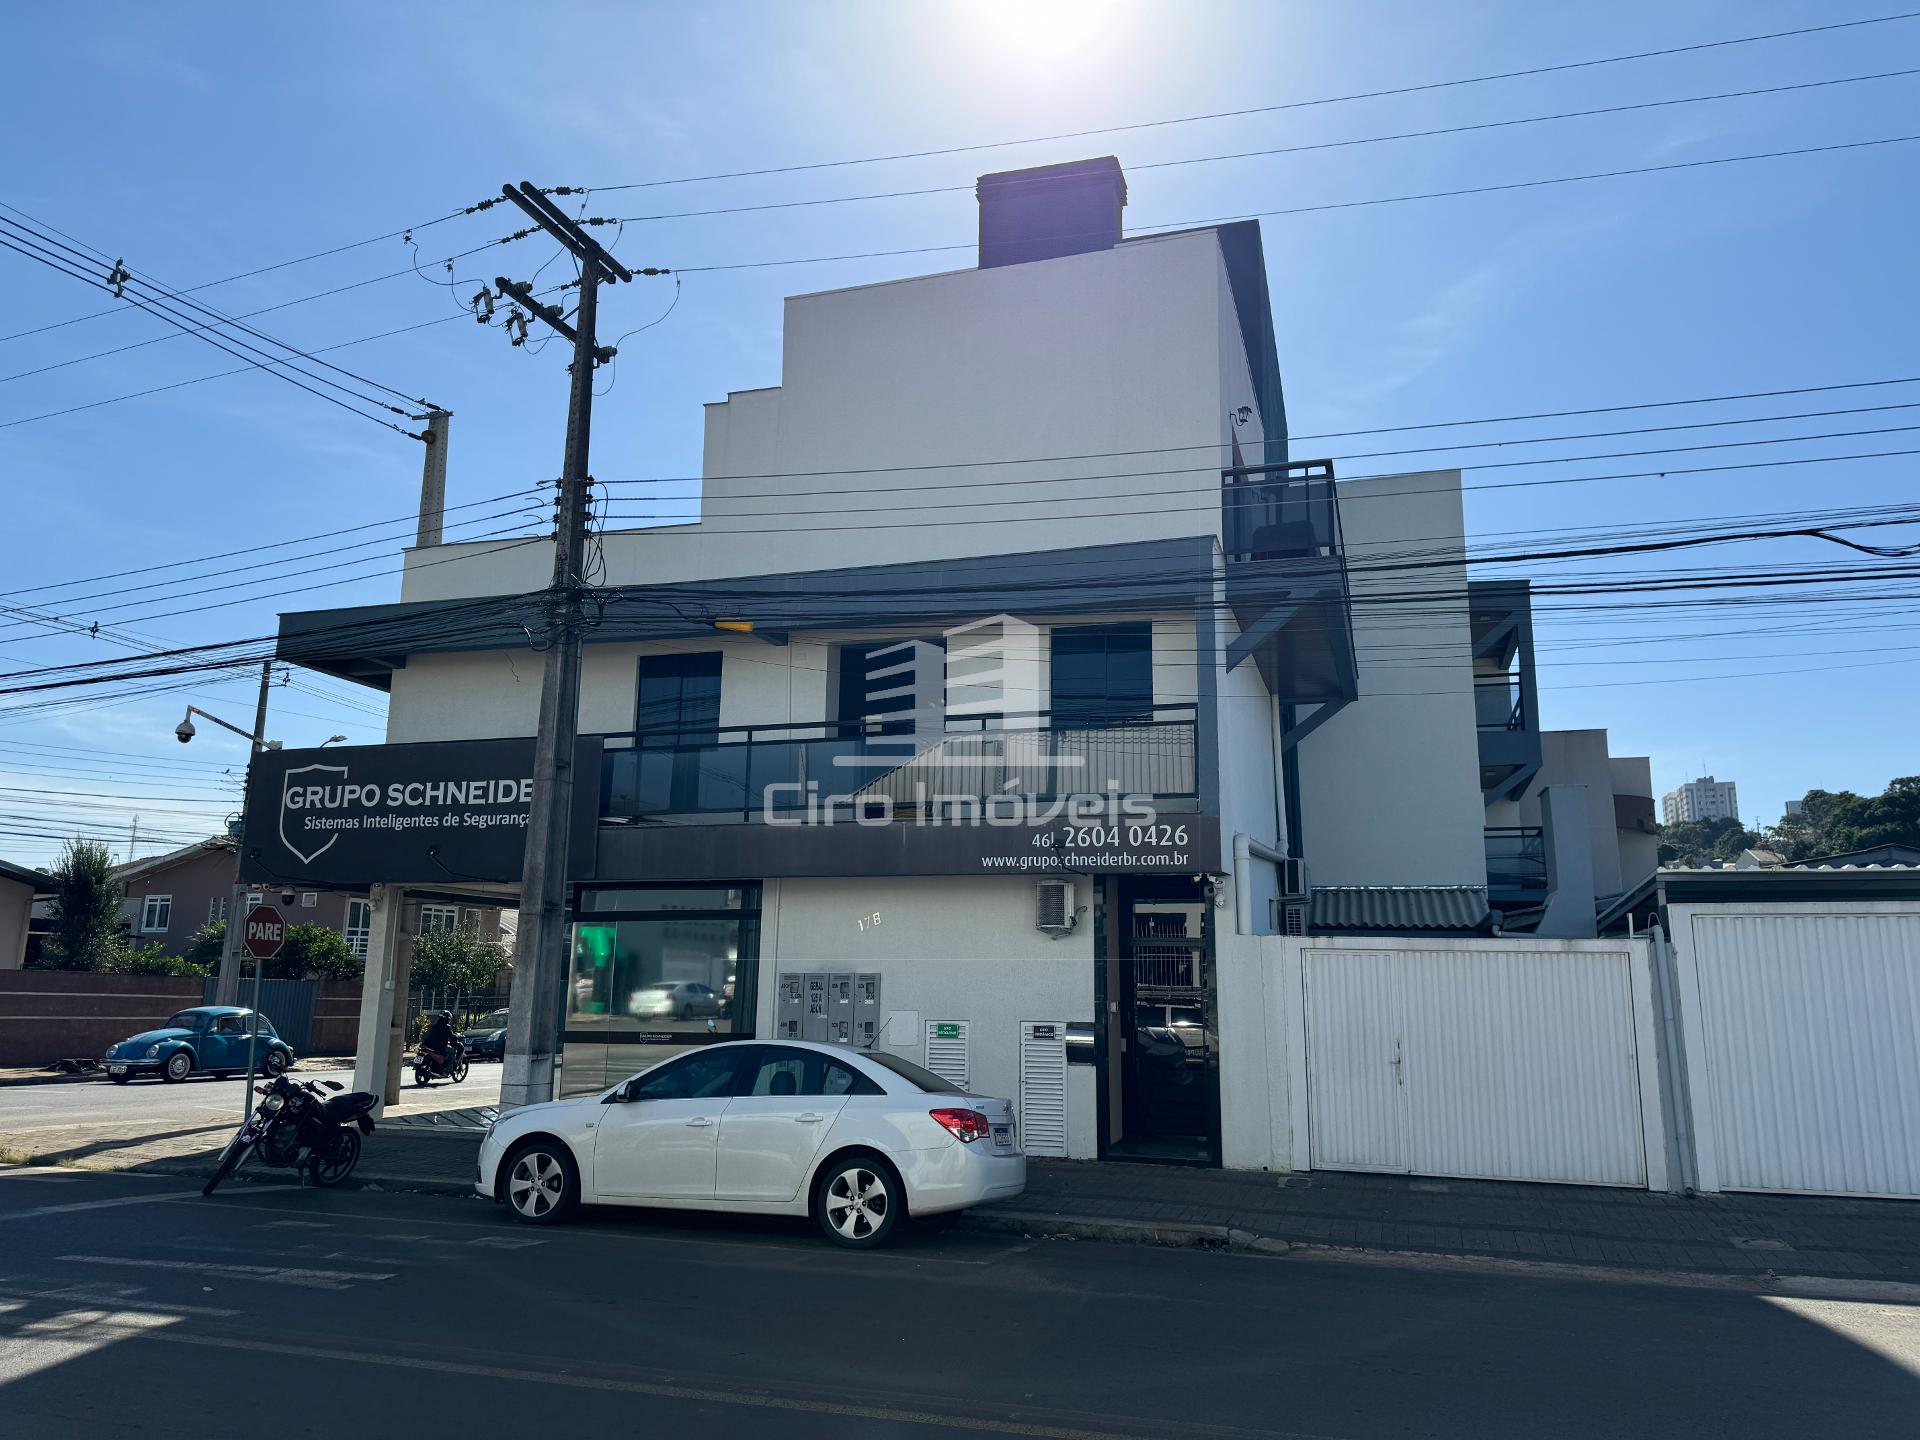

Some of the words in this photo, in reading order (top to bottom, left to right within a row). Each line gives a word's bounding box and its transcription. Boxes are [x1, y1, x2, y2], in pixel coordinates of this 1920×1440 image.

[285, 784, 380, 810] GRUPO
[386, 778, 534, 807] SCHNEIDE
[303, 815, 360, 830] Sistemas
[363, 812, 439, 831] Inteligentes
[442, 812, 459, 827] de
[1062, 826, 1120, 848] 2604
[1129, 824, 1189, 847] 0426
[248, 921, 282, 941] PARE
